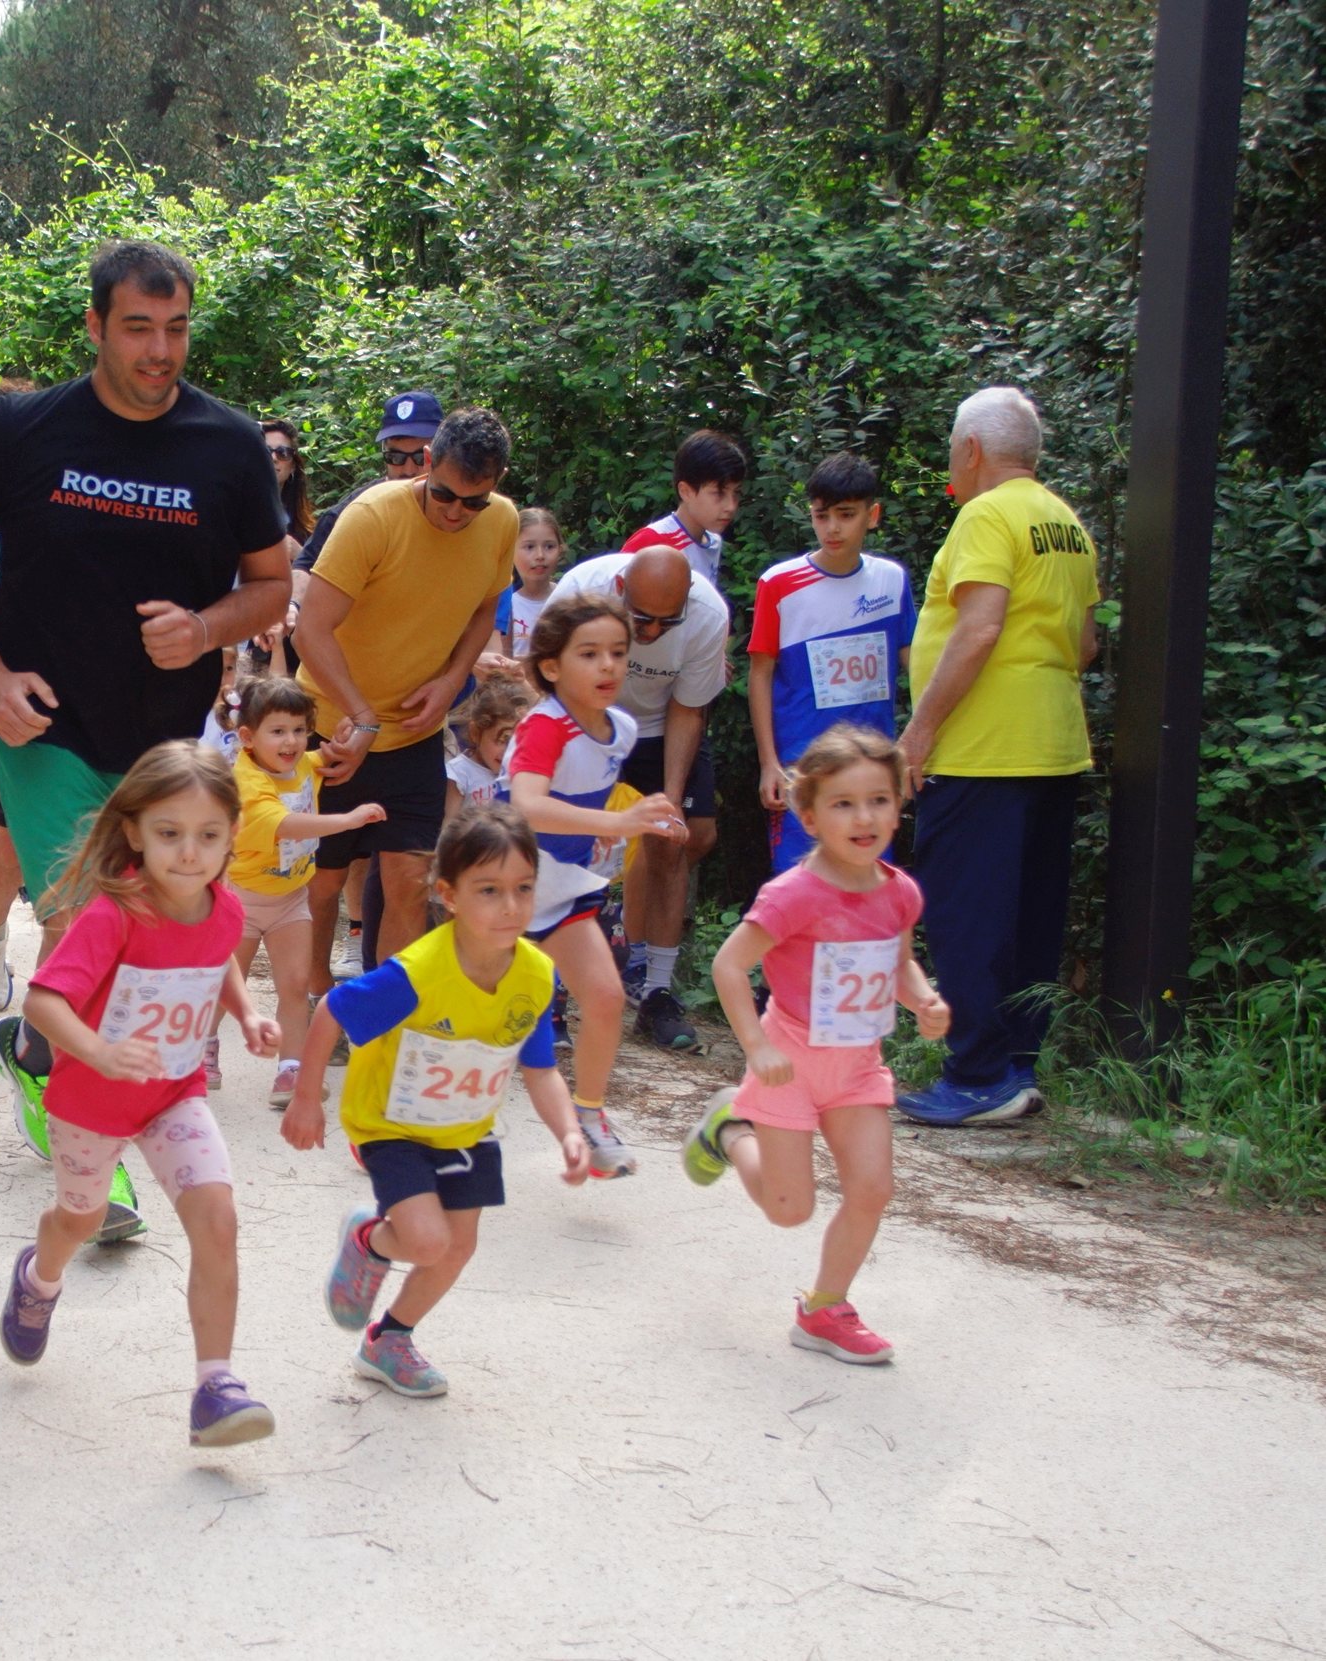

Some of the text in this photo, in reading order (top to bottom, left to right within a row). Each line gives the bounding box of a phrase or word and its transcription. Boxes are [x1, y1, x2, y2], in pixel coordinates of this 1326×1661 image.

[49, 489, 199, 527] ARMWRESTLING
[61, 469, 193, 510] ROOSTER
[827, 653, 878, 686] 260
[130, 1000, 214, 1045] 290
